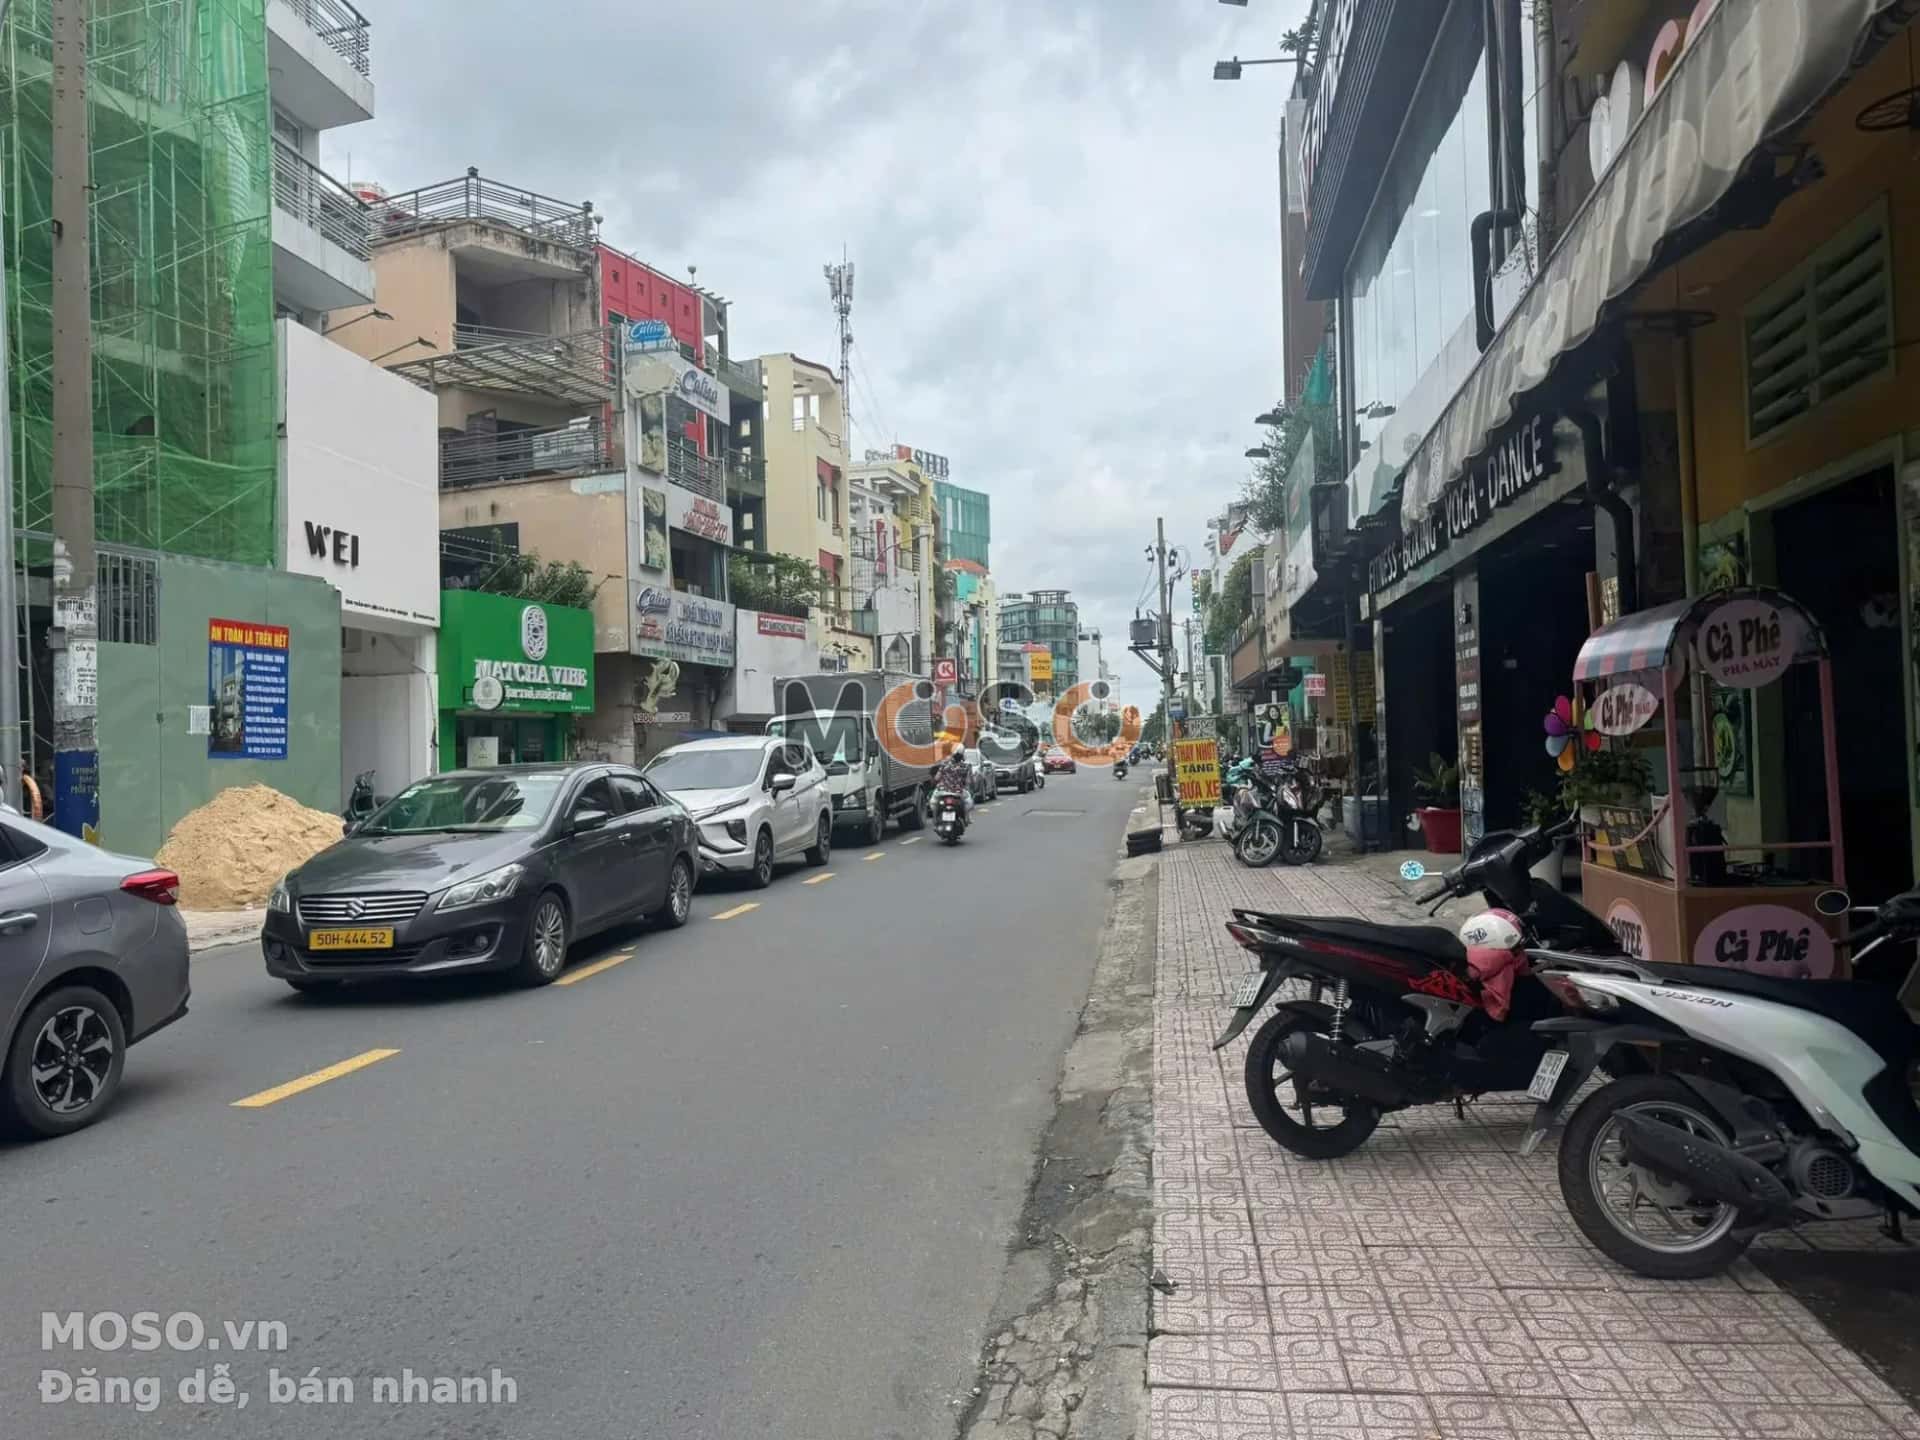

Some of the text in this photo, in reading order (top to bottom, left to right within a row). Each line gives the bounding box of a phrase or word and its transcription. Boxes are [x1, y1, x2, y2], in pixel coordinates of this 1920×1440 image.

[915, 449, 949, 478] SHB
[1445, 470, 1478, 540] YOGA
[1488, 415, 1543, 509] DANCE
[304, 520, 360, 568] WEI
[211, 625, 222, 641] AN
[1739, 610, 1780, 657] Phê
[475, 659, 588, 687] MATCHA VIBE
[1204, 778, 1220, 798] XE
[317, 932, 387, 946] 50H-444.52
[1755, 927, 1811, 962] Phê
[1651, 988, 1733, 1008] VISION
